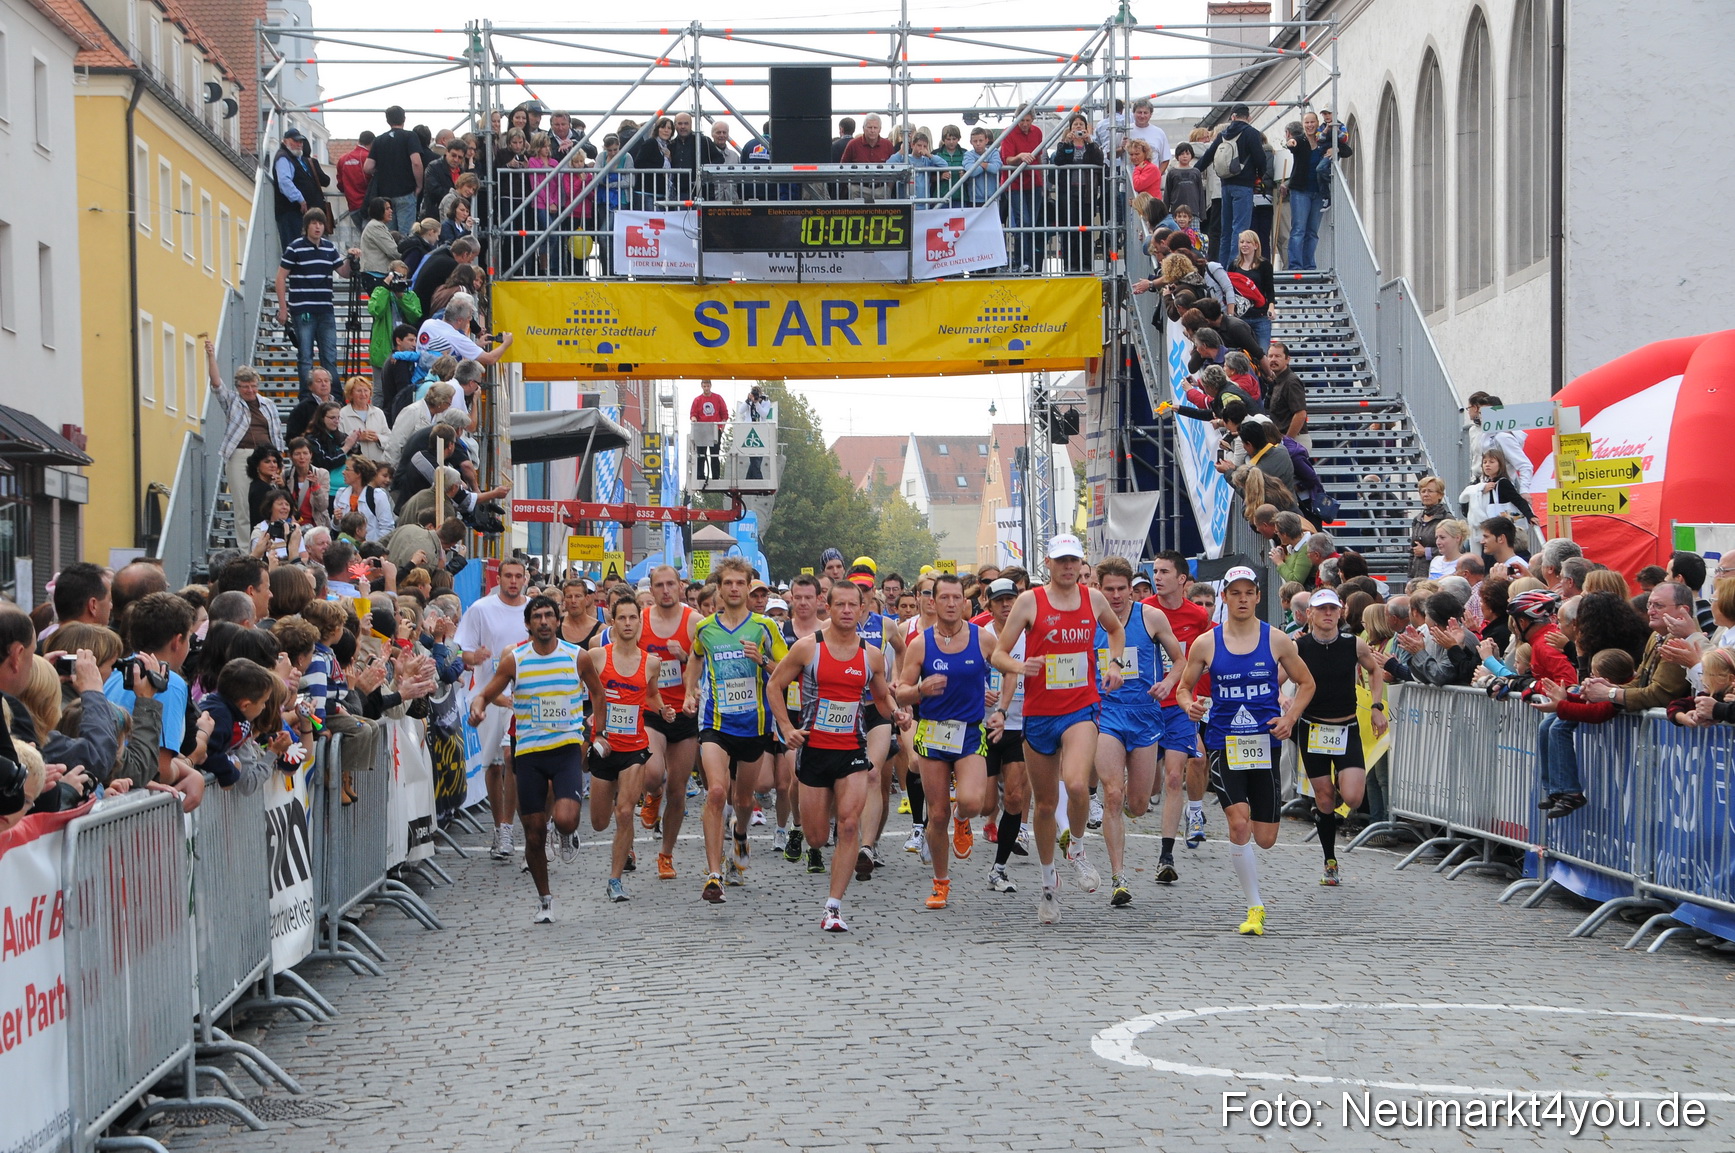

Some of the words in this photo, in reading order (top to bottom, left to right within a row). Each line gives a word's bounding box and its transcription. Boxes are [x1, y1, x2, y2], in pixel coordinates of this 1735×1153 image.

[767, 208, 813, 216] Elektronische
[816, 208, 902, 217] Sportstätteneinrichtungen
[800, 215, 904, 246] 10:00:05
[627, 245, 658, 257] DKMS
[768, 263, 843, 274] www.dkms.de
[692, 298, 900, 349] START
[938, 323, 1008, 335] Neumarkter
[1012, 322, 1068, 334] Stadtlauf
[526, 325, 598, 336] Neumarkter
[600, 325, 658, 338] Stadtlauf
[1576, 466, 1633, 483] pisierung
[1561, 490, 1607, 501] Kinder-
[513, 504, 535, 513] 09181
[1552, 502, 1615, 514] betreuung
[636, 510, 655, 518] 6352
[569, 542, 602, 550] Schnupper-
[604, 552, 623, 560] Block
[607, 561, 619, 577] A
[936, 560, 955, 568] Block
[1061, 627, 1091, 641] RONO
[725, 681, 746, 689] Michael
[728, 689, 753, 702] 2002
[612, 706, 627, 714] Marco
[829, 703, 846, 712] Oliver
[542, 708, 567, 718] 2256
[611, 714, 634, 724] 3315
[828, 713, 853, 724] 2000
[944, 731, 951, 741] 4
[1322, 735, 1341, 745] 348
[1237, 738, 1257, 746] Dorian
[1242, 748, 1264, 758] 903
[2, 894, 47, 962] Audi
